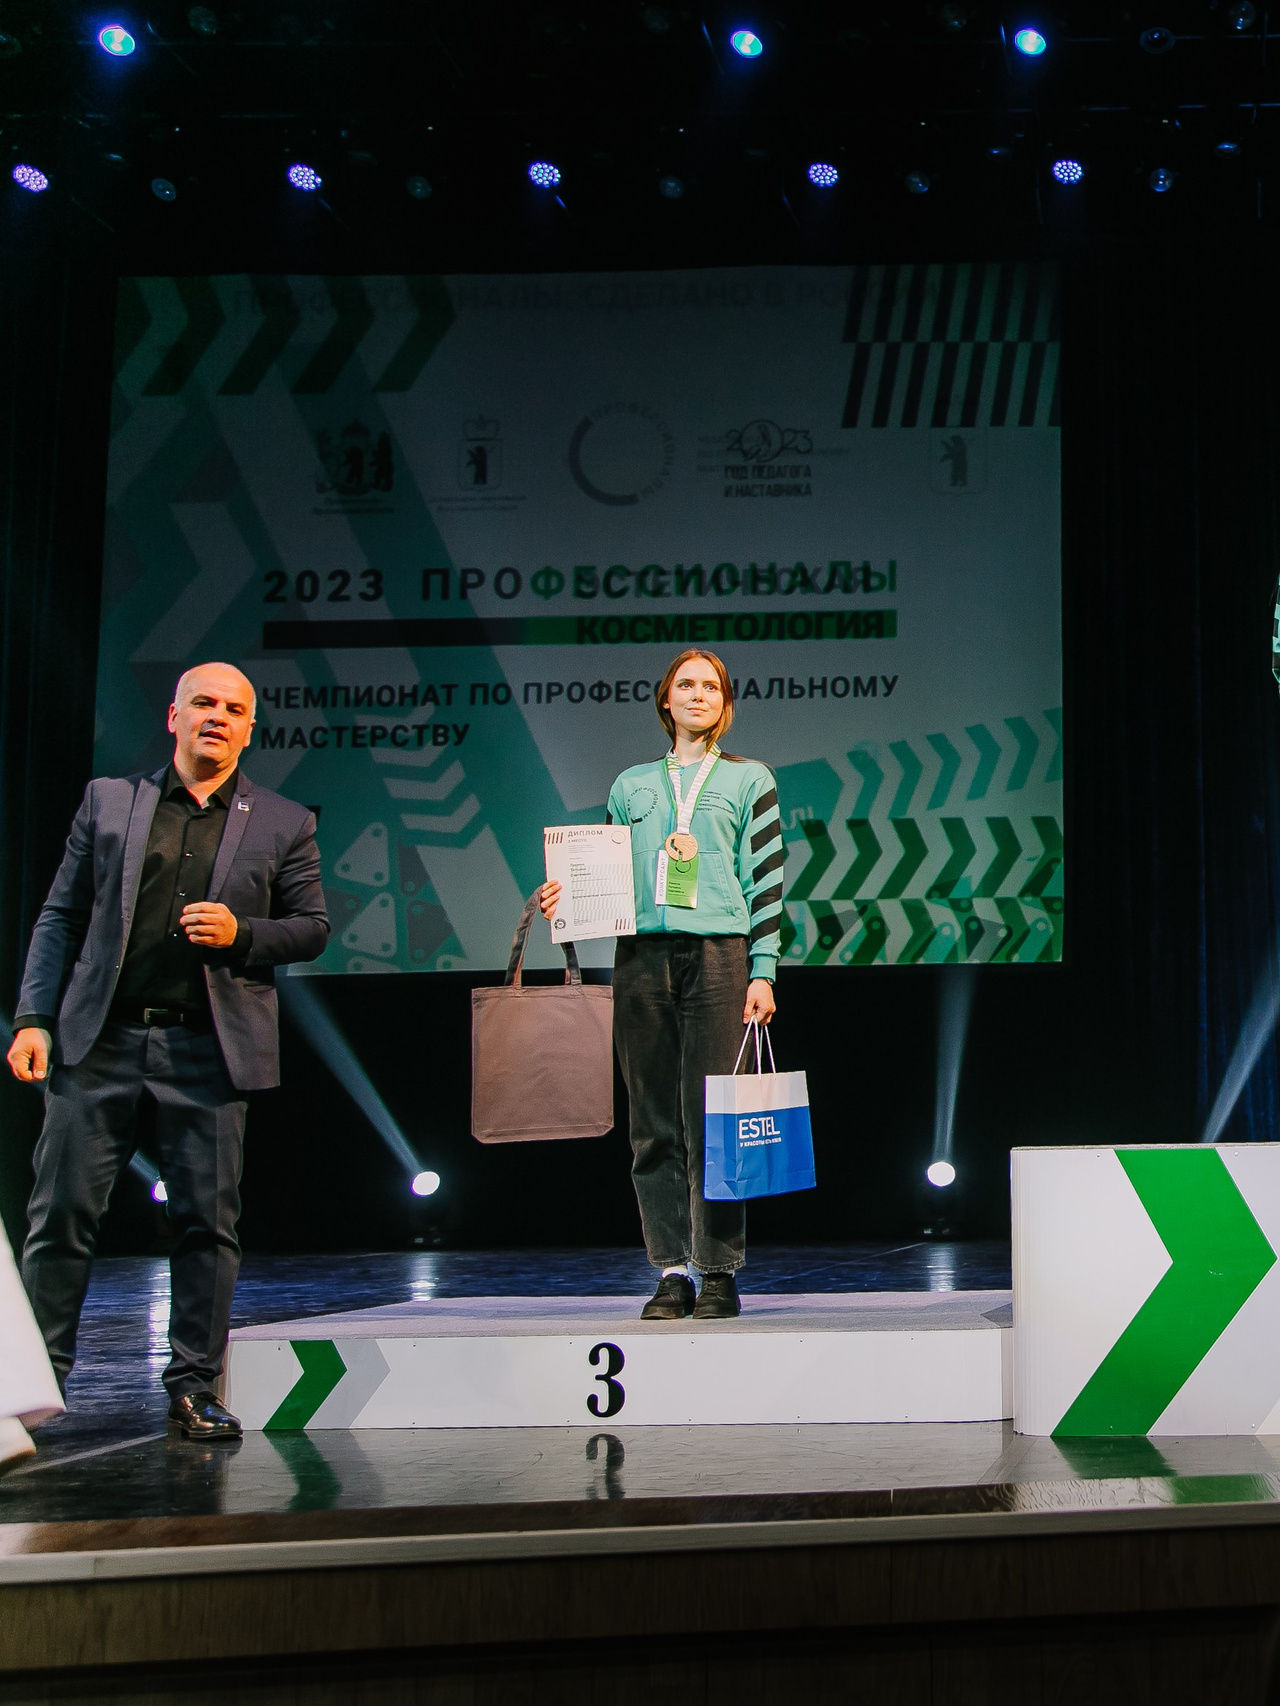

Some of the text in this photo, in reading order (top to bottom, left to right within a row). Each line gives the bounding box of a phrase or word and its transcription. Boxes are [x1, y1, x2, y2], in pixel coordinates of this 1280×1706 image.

[725, 464, 748, 480] ГОД
[752, 464, 811, 479] ПЕДАГОГА
[725, 483, 812, 497] И НАСТАВНИКА
[264, 559, 897, 603] 2023 ПРОФЕССИОНАЛЫ
[577, 611, 885, 645] КОСМЕТОЛОГИЯ
[262, 674, 900, 710] ЧЕМПИОНАТ ПО ПРОФЕСАЛЬНОМУ
[260, 723, 471, 750] МАСТЕРСТВУ
[567, 830, 603, 838] ДИПЛОМ
[738, 1116, 780, 1140] ESTEL
[587, 1342, 625, 1418] 3
